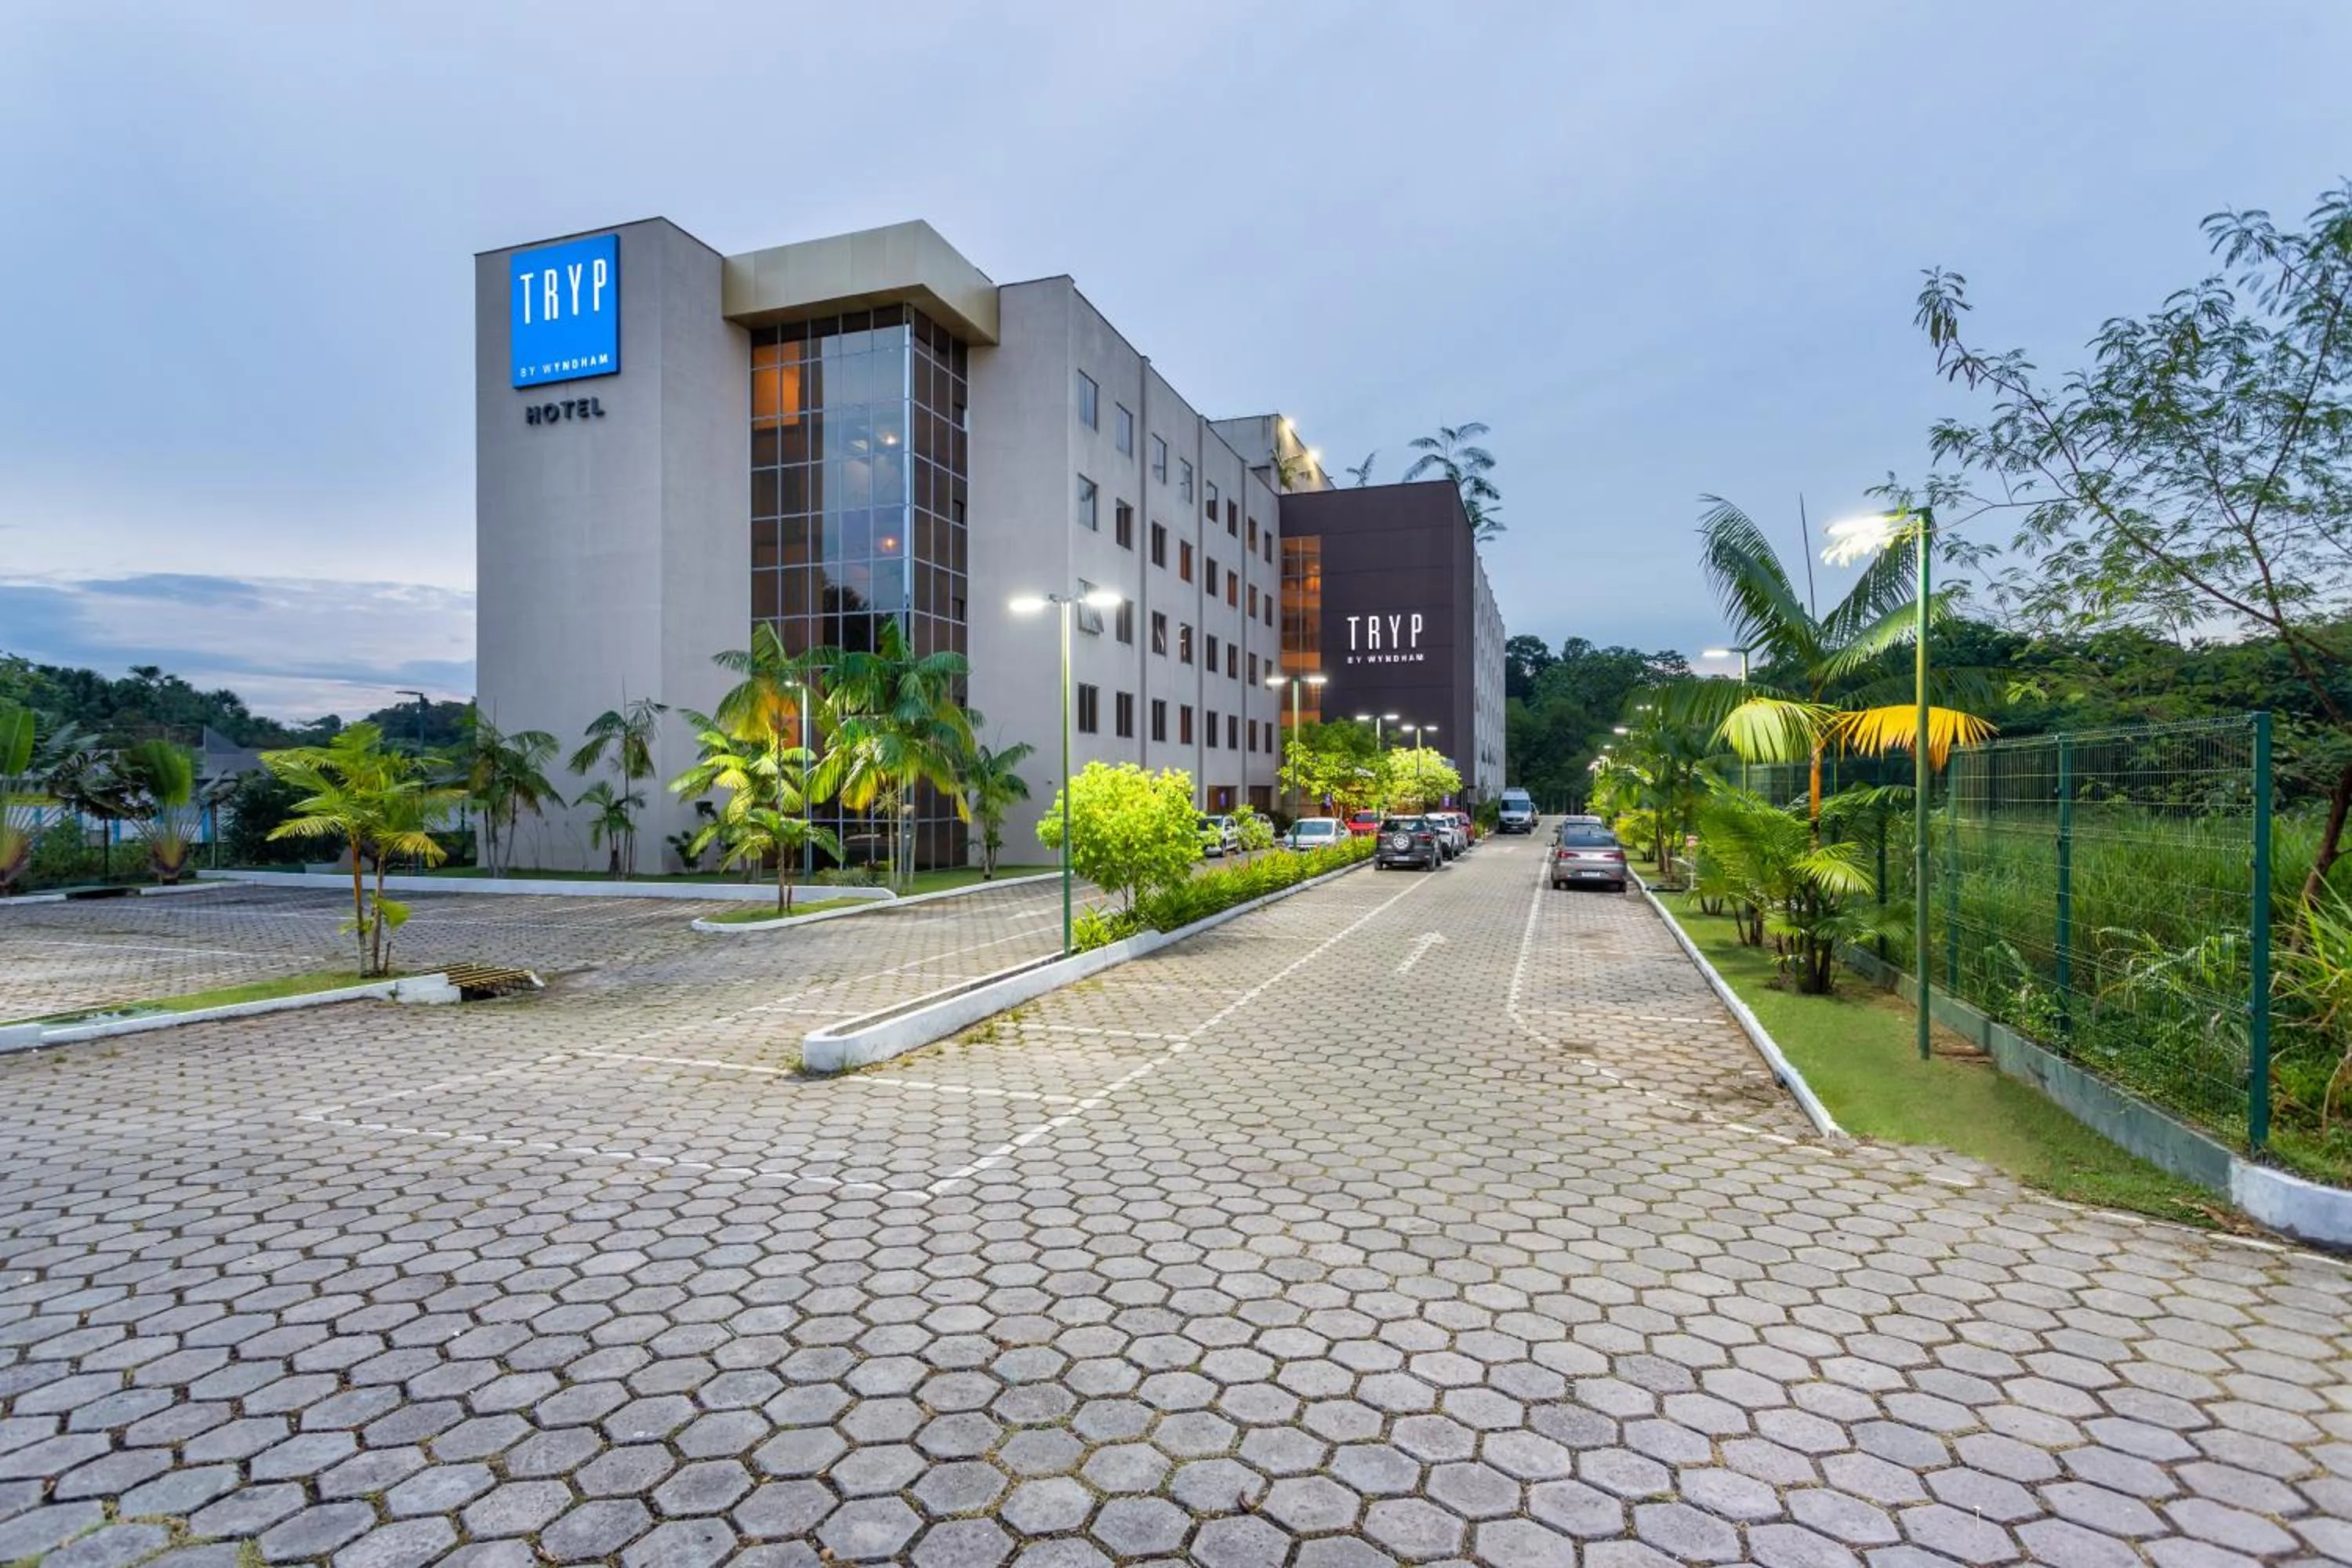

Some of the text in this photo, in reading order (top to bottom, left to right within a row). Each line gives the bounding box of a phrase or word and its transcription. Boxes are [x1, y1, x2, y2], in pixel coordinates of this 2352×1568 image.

[520, 258, 608, 325] TRYP
[520, 353, 608, 378] BY WYNDHAM
[526, 396, 606, 426] HOTEL
[1346, 614, 1423, 651] TRYP
[1347, 653, 1425, 664] BY WYNDHAM
